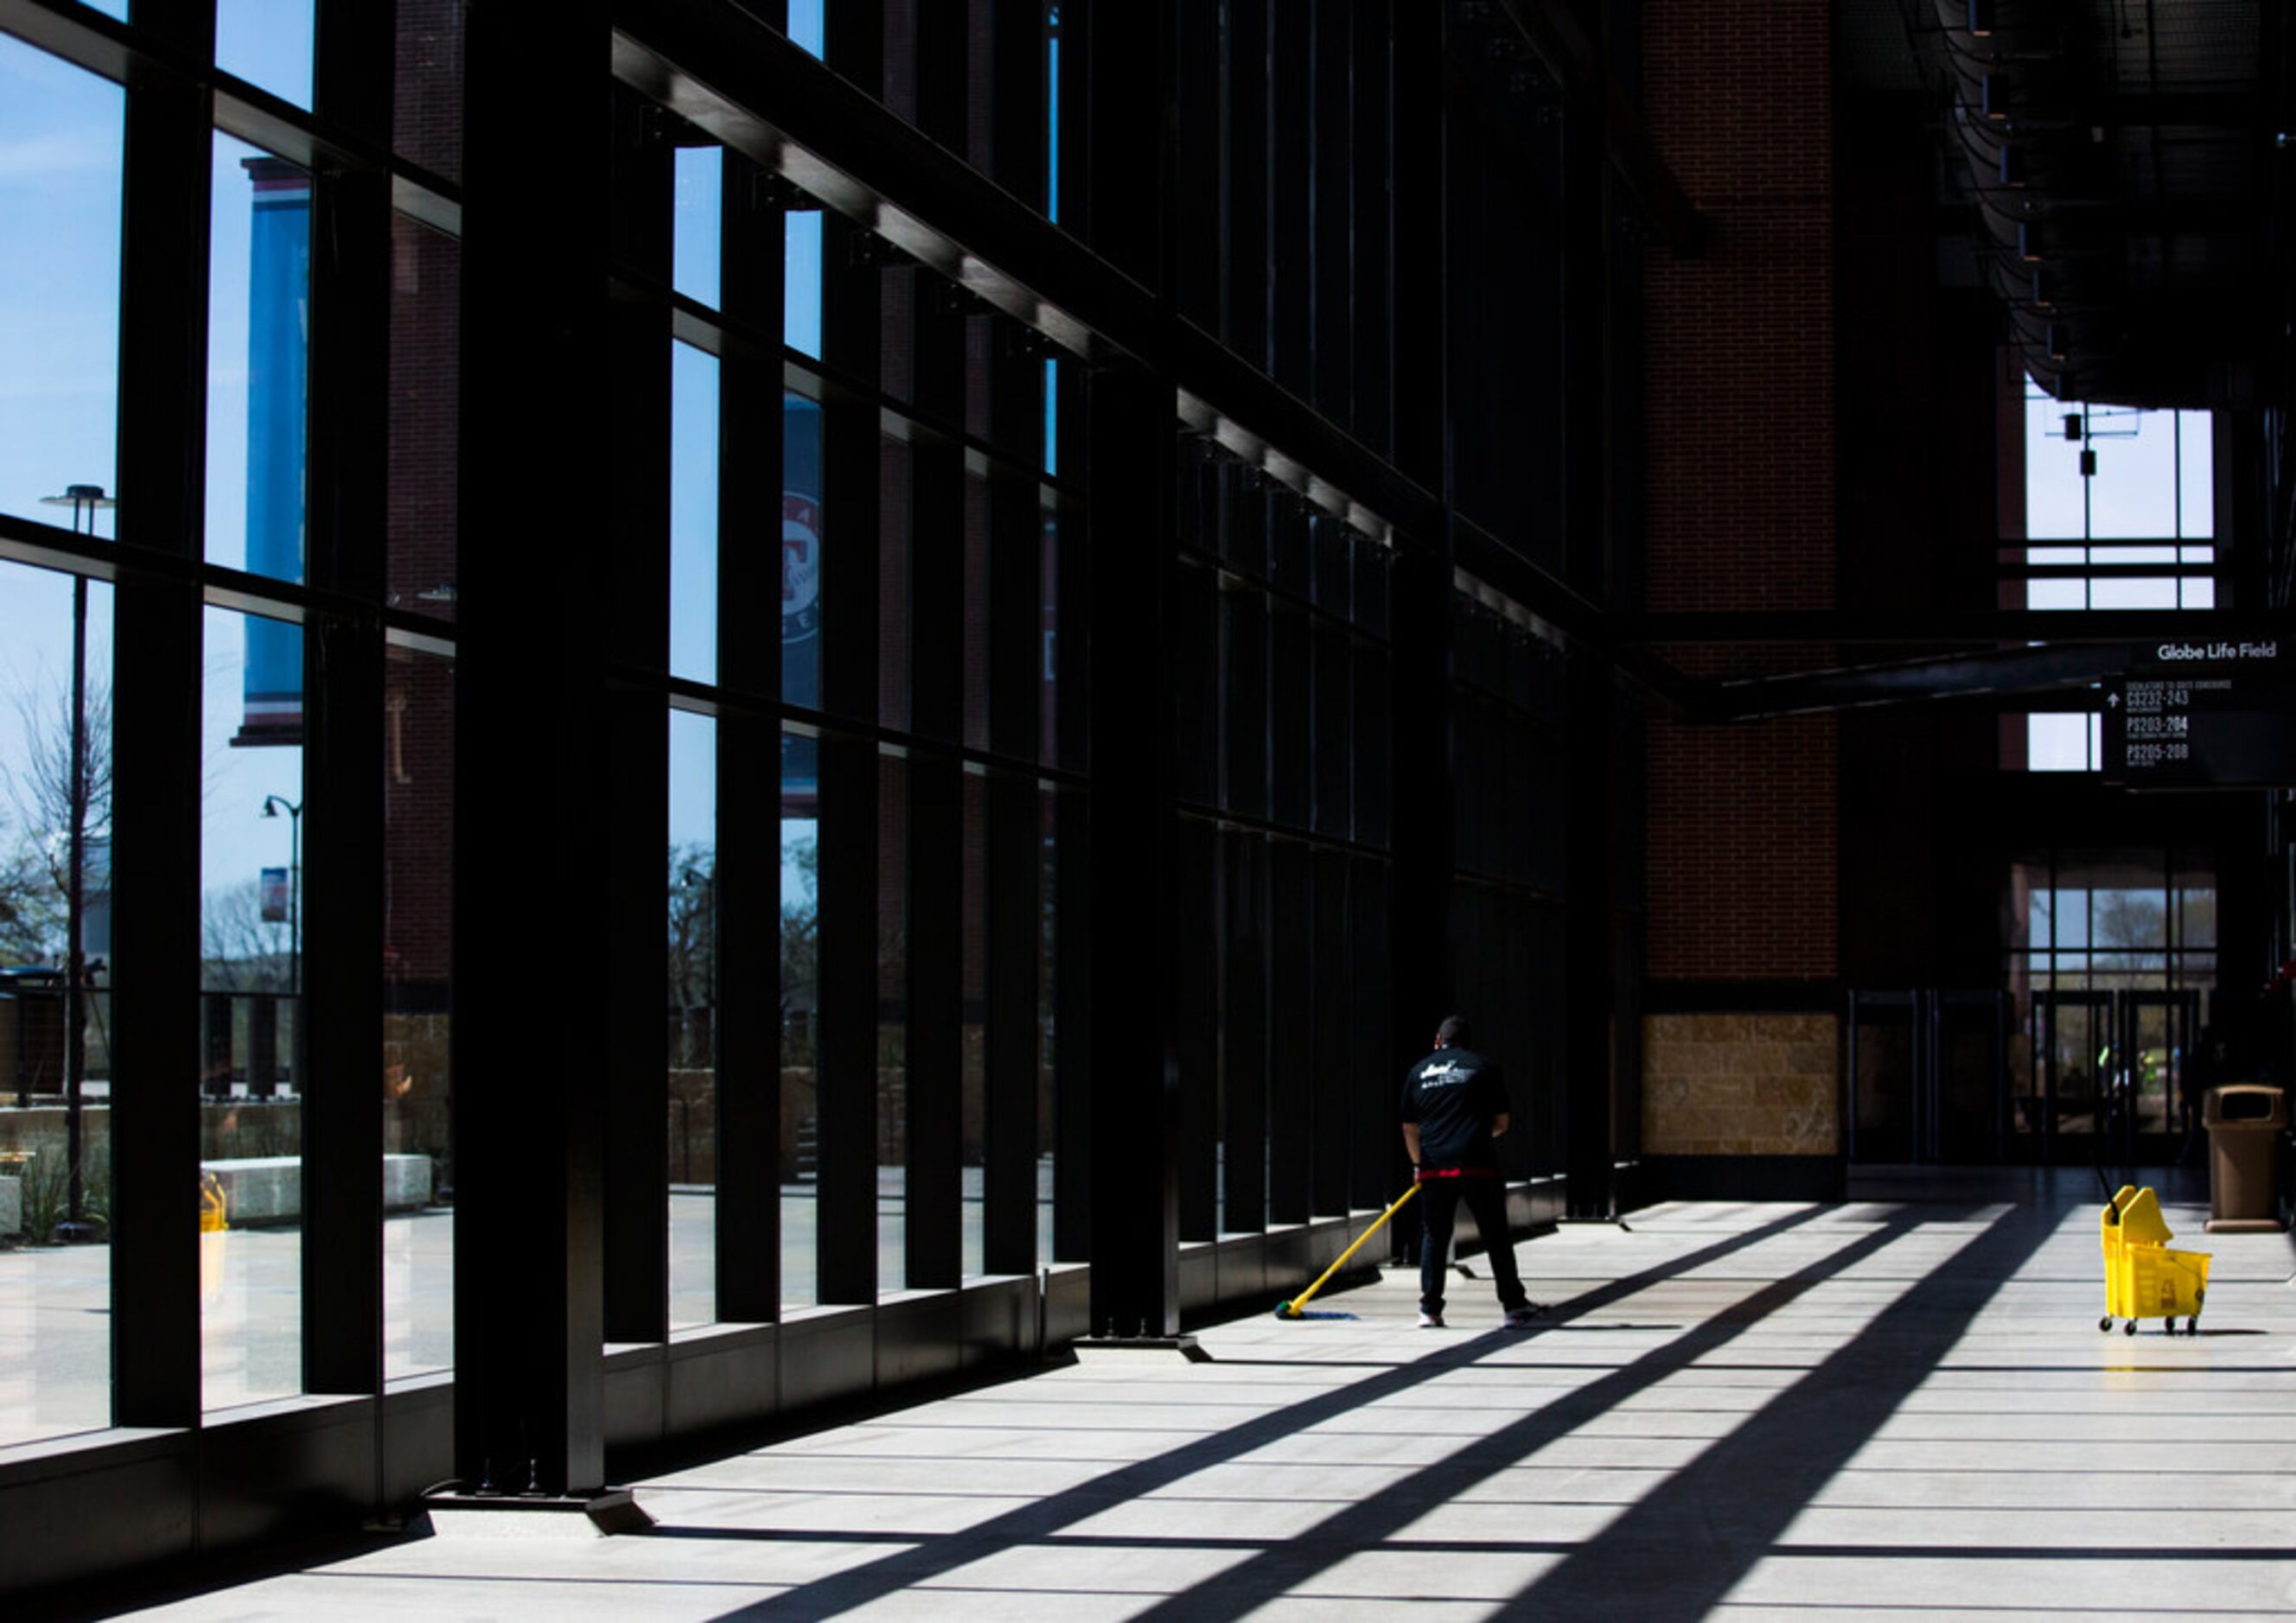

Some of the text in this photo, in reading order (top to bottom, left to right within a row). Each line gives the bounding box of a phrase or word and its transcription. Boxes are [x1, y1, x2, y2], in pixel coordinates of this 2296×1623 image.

[2159, 641, 2275, 659] Globe Life Field
[2127, 691, 2189, 706] CS232-243
[2127, 716, 2188, 732] PS203-204
